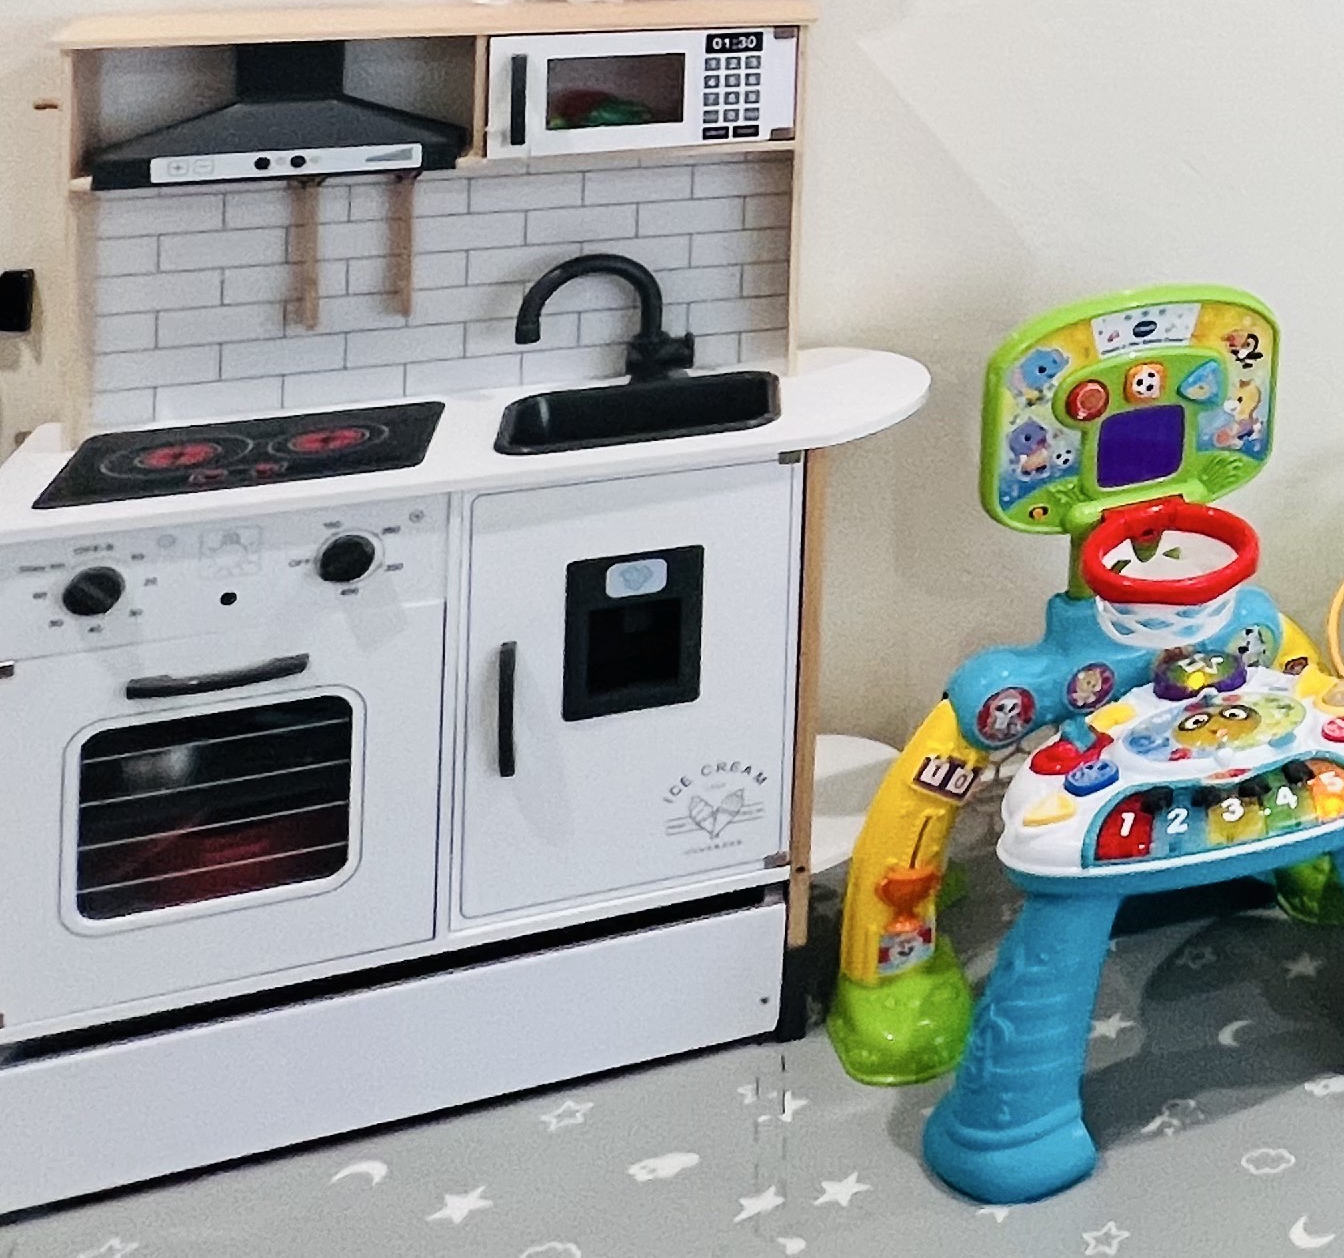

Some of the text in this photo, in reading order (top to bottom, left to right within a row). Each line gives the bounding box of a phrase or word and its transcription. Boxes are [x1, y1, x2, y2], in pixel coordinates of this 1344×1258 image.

[712, 36, 756, 49] 01:30
[663, 761, 768, 804] ICE CREAM
[1120, 811, 1137, 838] 1
[1166, 807, 1190, 835] 2
[1220, 797, 1245, 823] 3
[1275, 785, 1299, 810] 4
